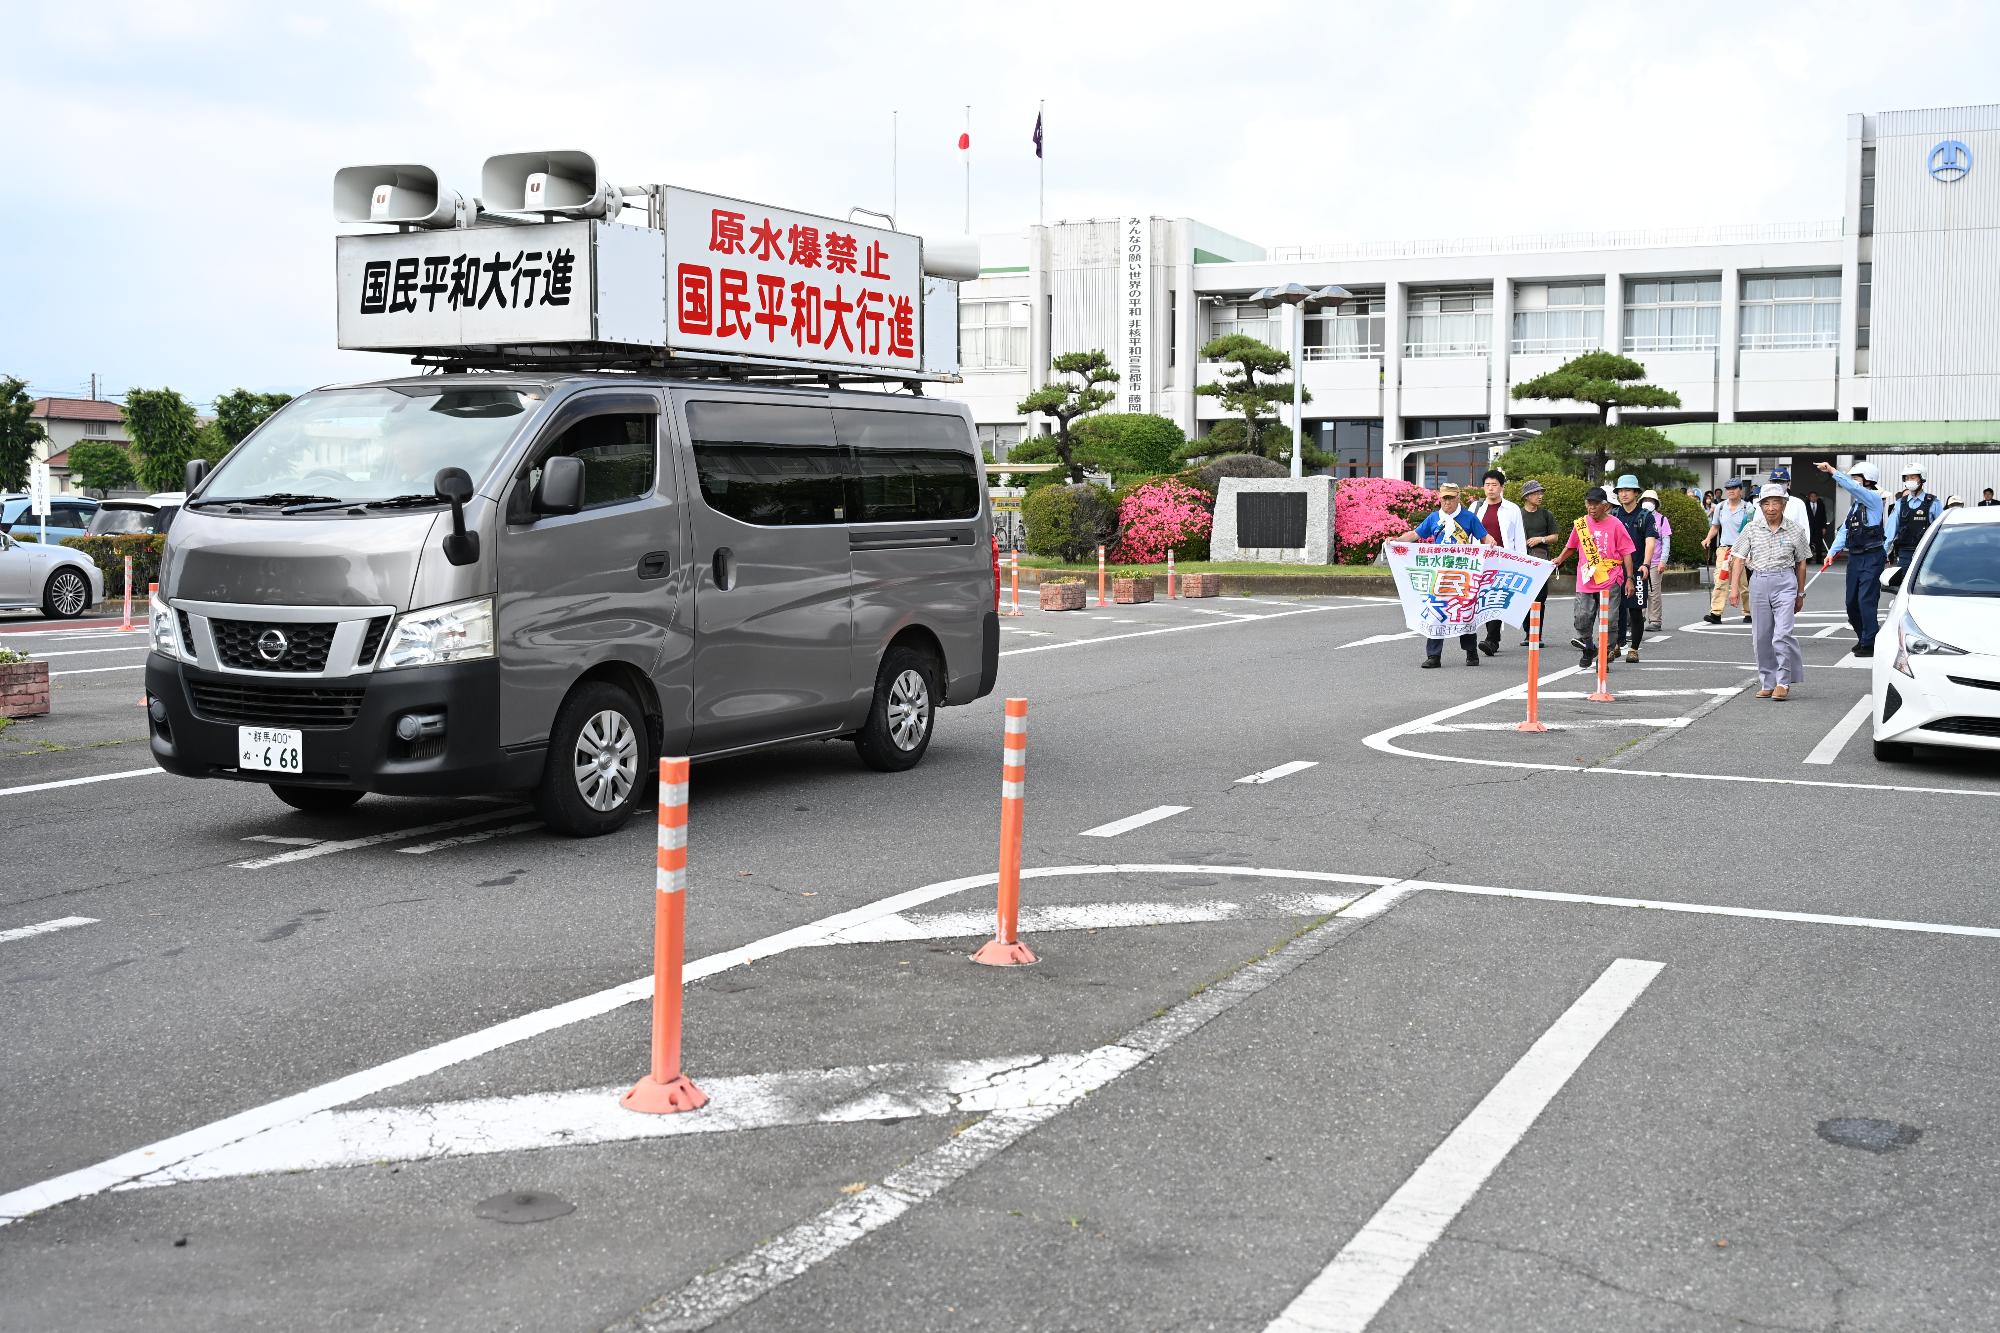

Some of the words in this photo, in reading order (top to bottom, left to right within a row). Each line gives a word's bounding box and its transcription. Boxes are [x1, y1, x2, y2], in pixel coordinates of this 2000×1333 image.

[709, 208, 891, 281] 原水爆禁止
[1129, 217, 1142, 316] みんなの願い世界の平和
[361, 247, 575, 315] 国民平和大行進
[678, 263, 914, 359] 国民平和大行進
[1416, 555, 1482, 572] 原水爆禁止
[1420, 588, 1515, 623] 大行進
